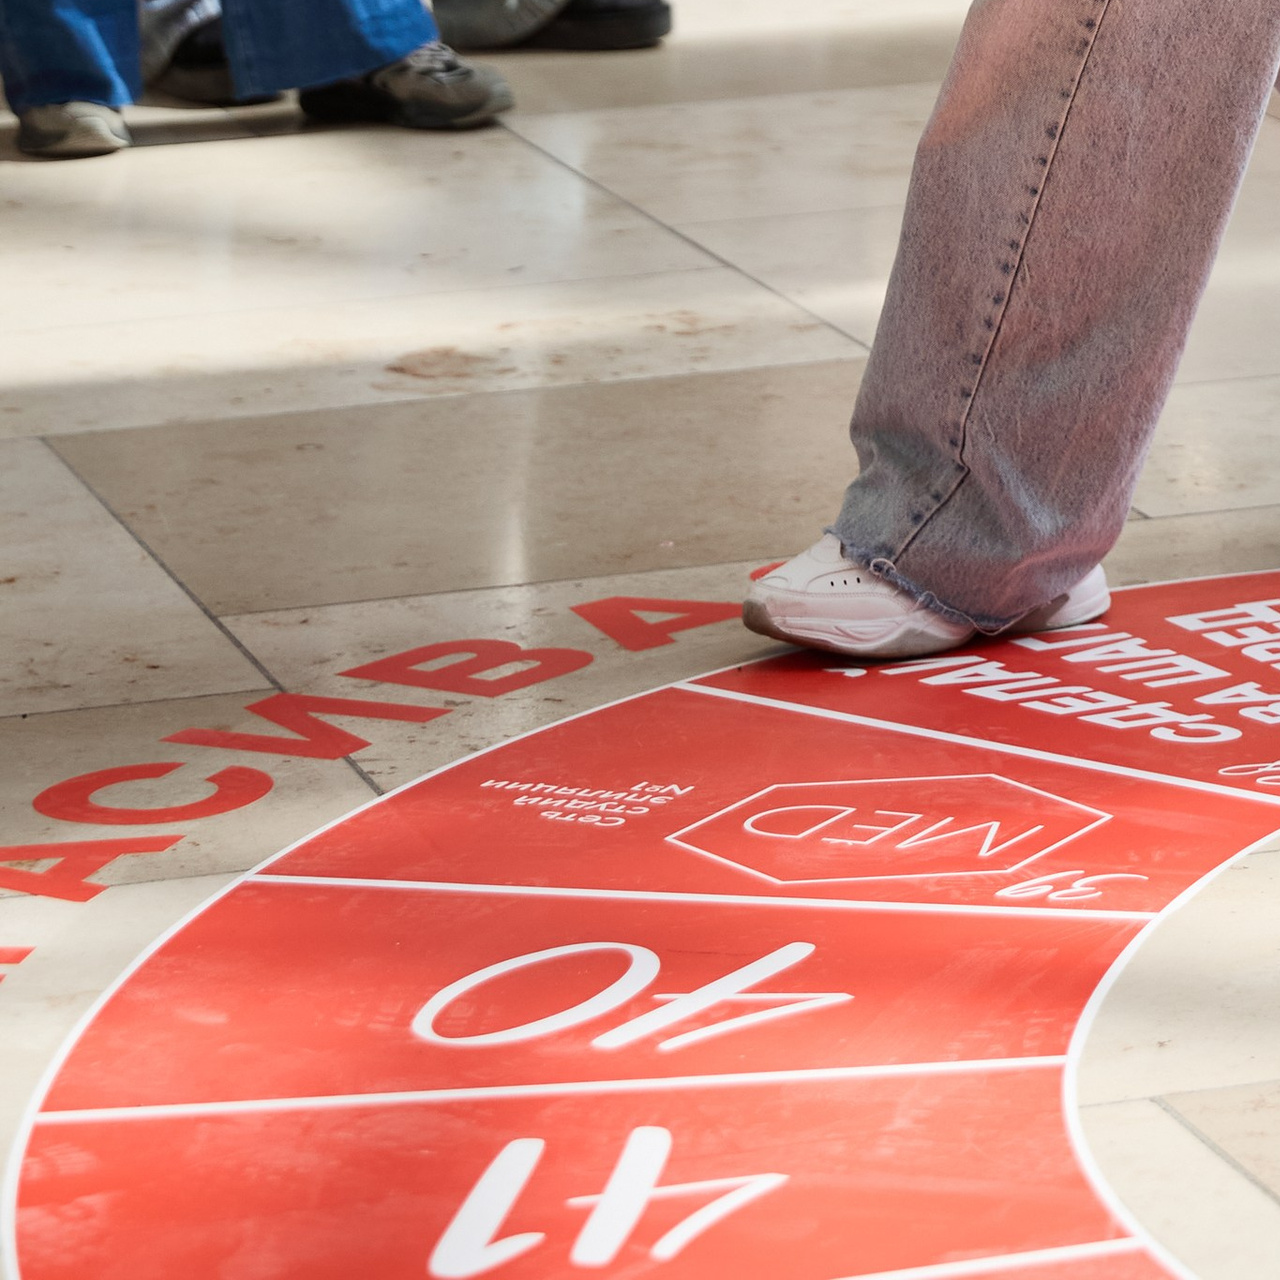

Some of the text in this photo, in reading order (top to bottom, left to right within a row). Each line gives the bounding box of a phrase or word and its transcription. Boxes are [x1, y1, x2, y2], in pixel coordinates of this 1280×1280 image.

[1009, 622, 1234, 689] ШАГ
[479, 779, 675, 805] эпиляции
[629, 781, 695, 796] №1
[512, 795, 651, 816] студий
[539, 810, 627, 828] Сеть
[994, 870, 1151, 901] 39
[410, 940, 856, 1053] 40
[427, 1125, 791, 1278] 41
